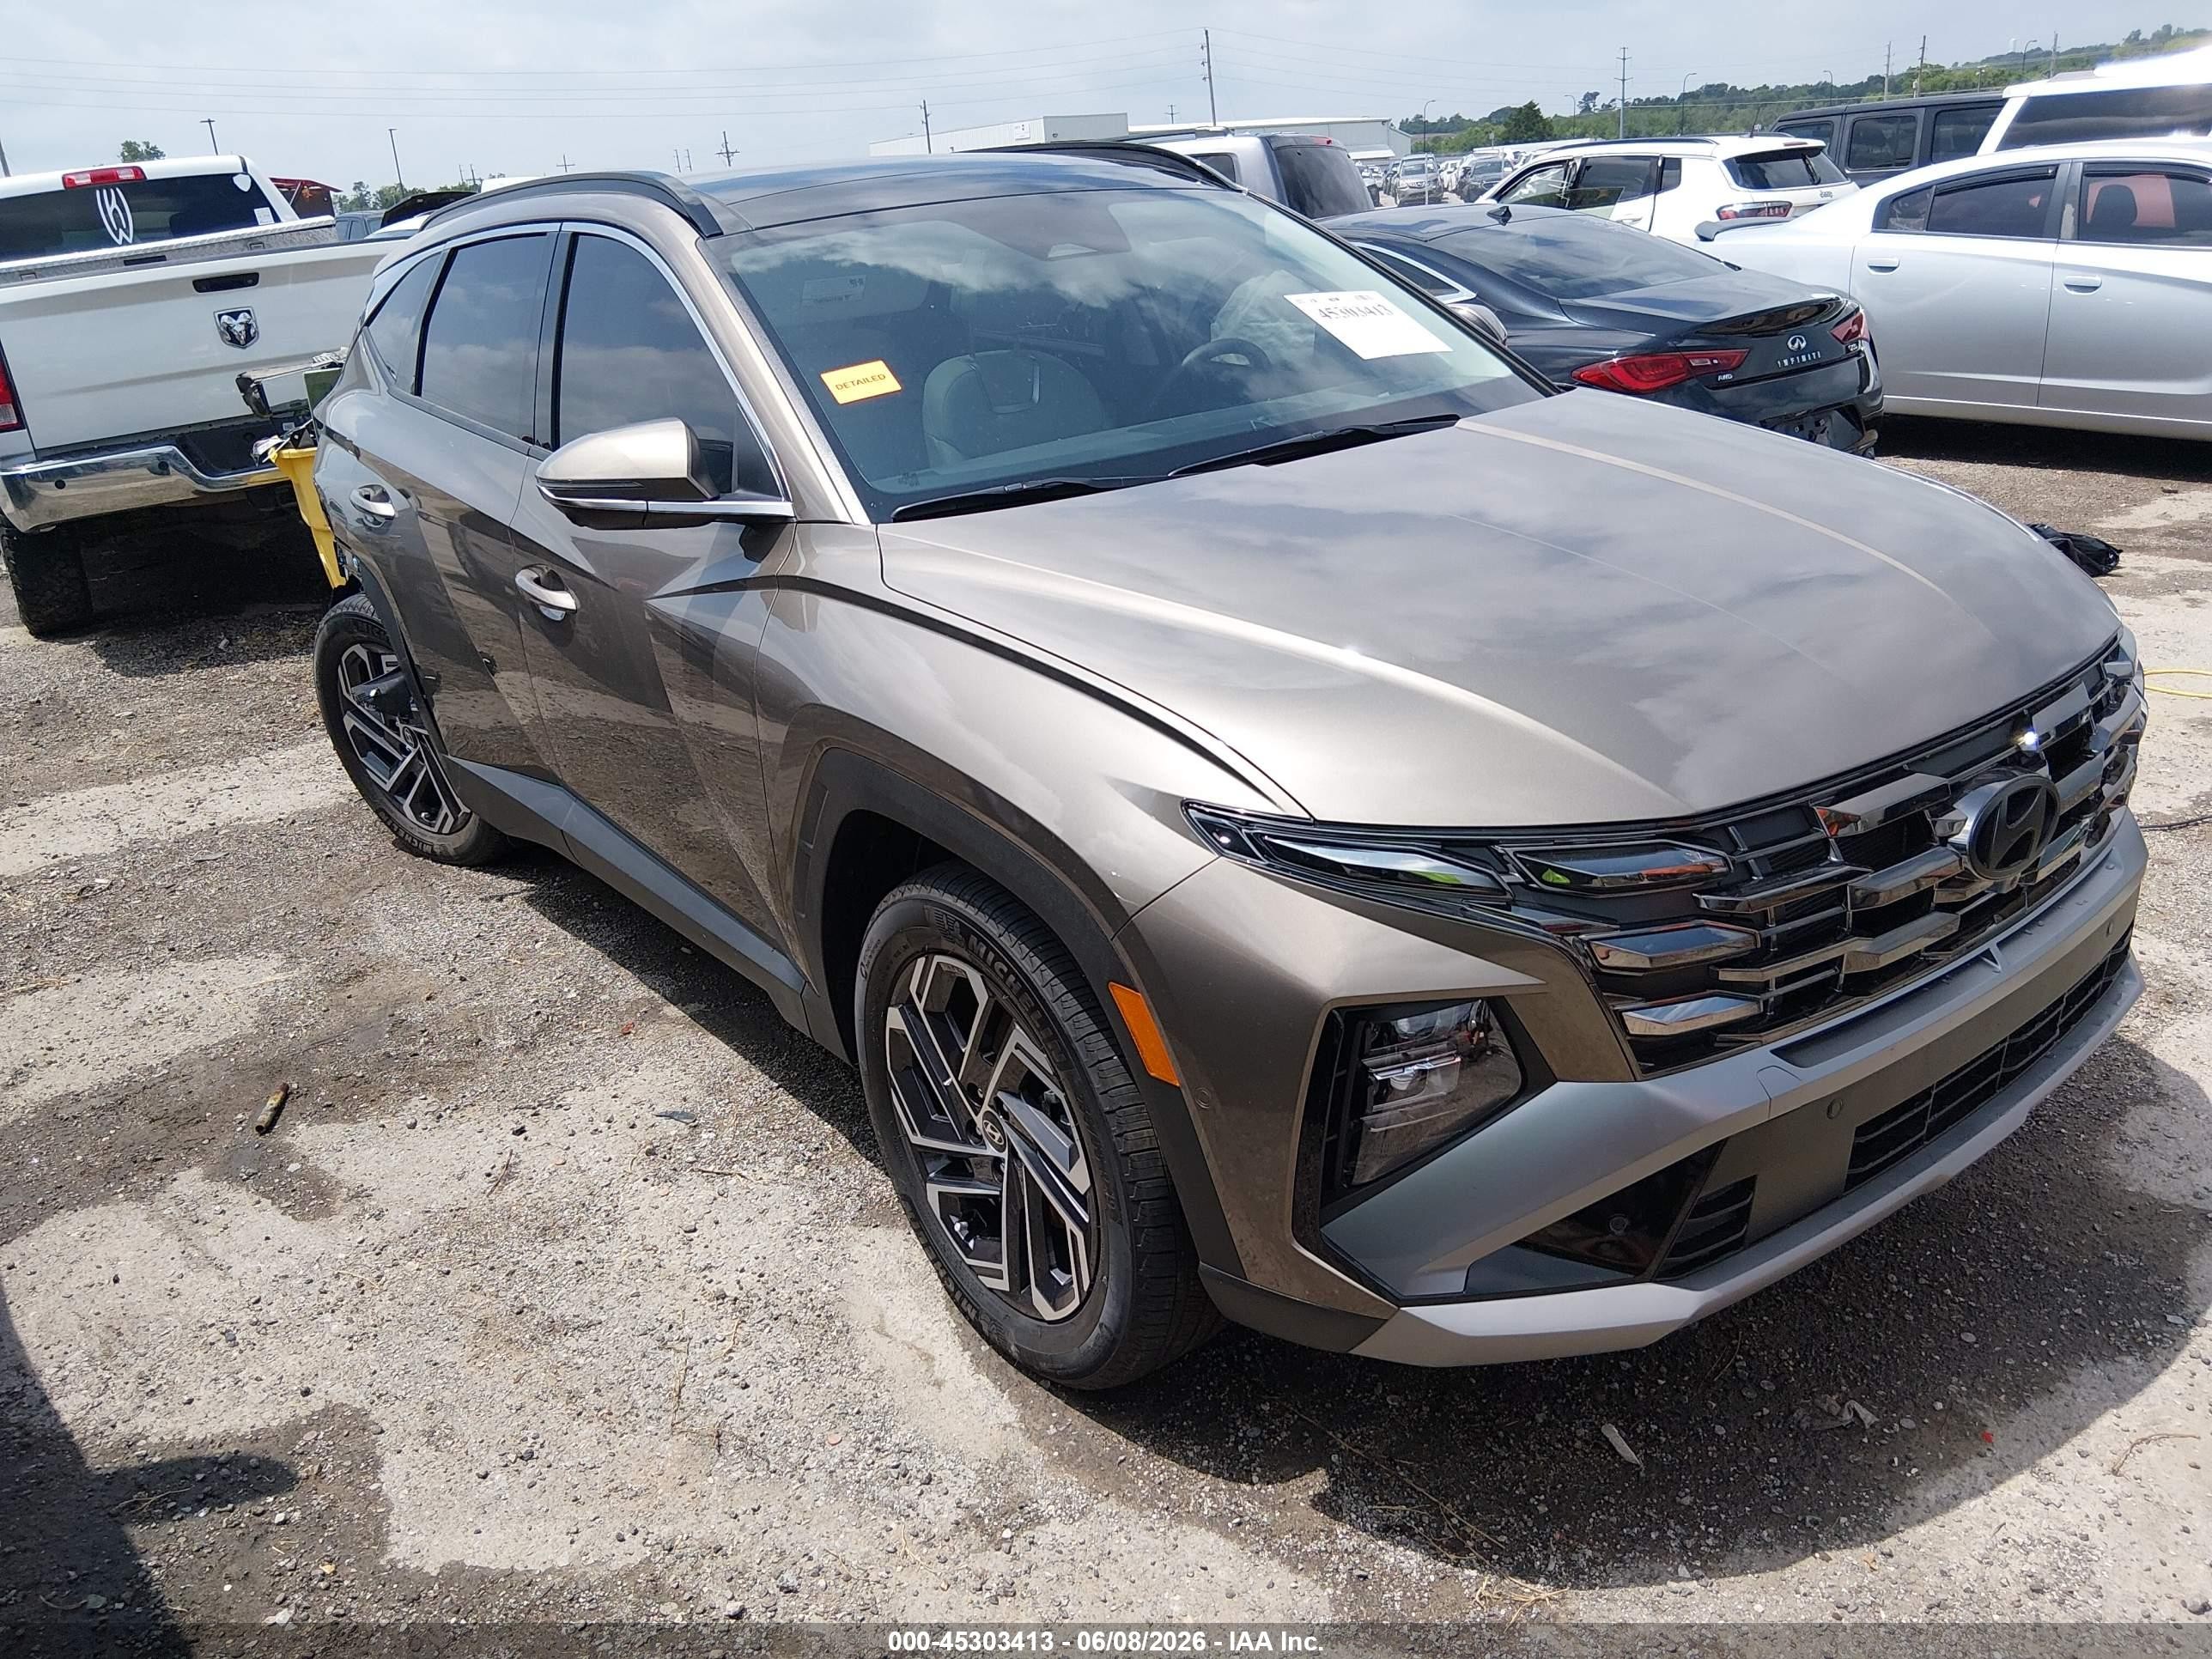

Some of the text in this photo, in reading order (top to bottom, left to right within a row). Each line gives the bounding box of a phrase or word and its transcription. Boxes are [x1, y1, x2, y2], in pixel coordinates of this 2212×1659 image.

[1318, 304, 1394, 319] 45303413
[1777, 350, 1822, 368] INFINITI
[835, 374, 886, 391] DETAILED
[967, 934, 1068, 1066] MICHELIN
